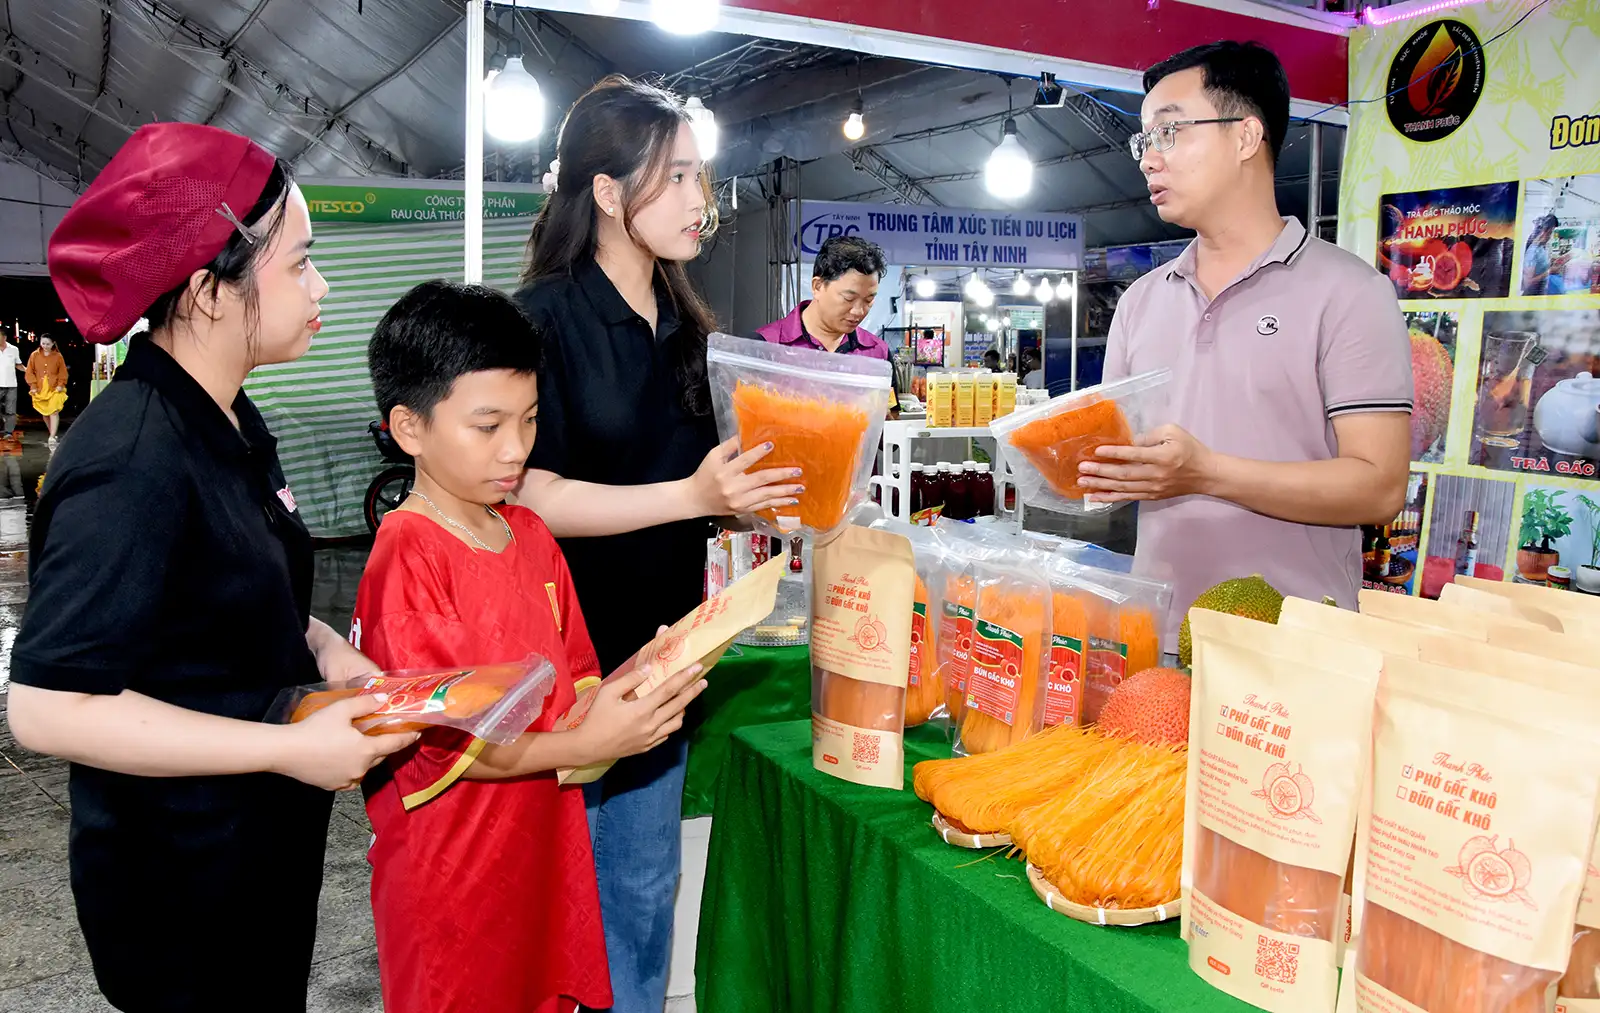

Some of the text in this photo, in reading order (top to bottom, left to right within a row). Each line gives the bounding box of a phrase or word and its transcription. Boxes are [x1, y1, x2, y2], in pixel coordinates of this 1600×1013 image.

[1403, 114, 1460, 132] THANH PHÚC
[1550, 114, 1600, 150] Đơn
[425, 195, 455, 207] CÔNG
[1406, 203, 1481, 218] TRÀ GẤC THẢO MỘC
[391, 209, 413, 220] RAU
[414, 208, 437, 220] QUẢ
[868, 211, 1077, 243] TRUNG TÂM XÚC TIẾN DU LỊCH
[1447, 218, 1488, 237] PHÚC
[925, 236, 1028, 264] TỈNH TÂY NINH
[1511, 456, 1595, 476] TRÀ GẤC
[832, 584, 872, 601] PHỞ GẤC KHÔ
[855, 603, 869, 613] KHÔ
[974, 666, 988, 677] BÚN
[988, 671, 1000, 683] GẤC
[1000, 678, 1016, 688] KHÔ
[1054, 682, 1072, 693] KHÔ
[1242, 693, 1269, 712] Thanh
[1229, 709, 1292, 740] PHỞ GẤC KHÔ
[1225, 725, 1287, 759] BÚN GẤC KHÔ
[1431, 751, 1494, 784] Thanh Phúc
[1414, 769, 1498, 810] PHỞ GẤC KHÔ
[1408, 789, 1492, 831] BÚN GẤC KHÔ
